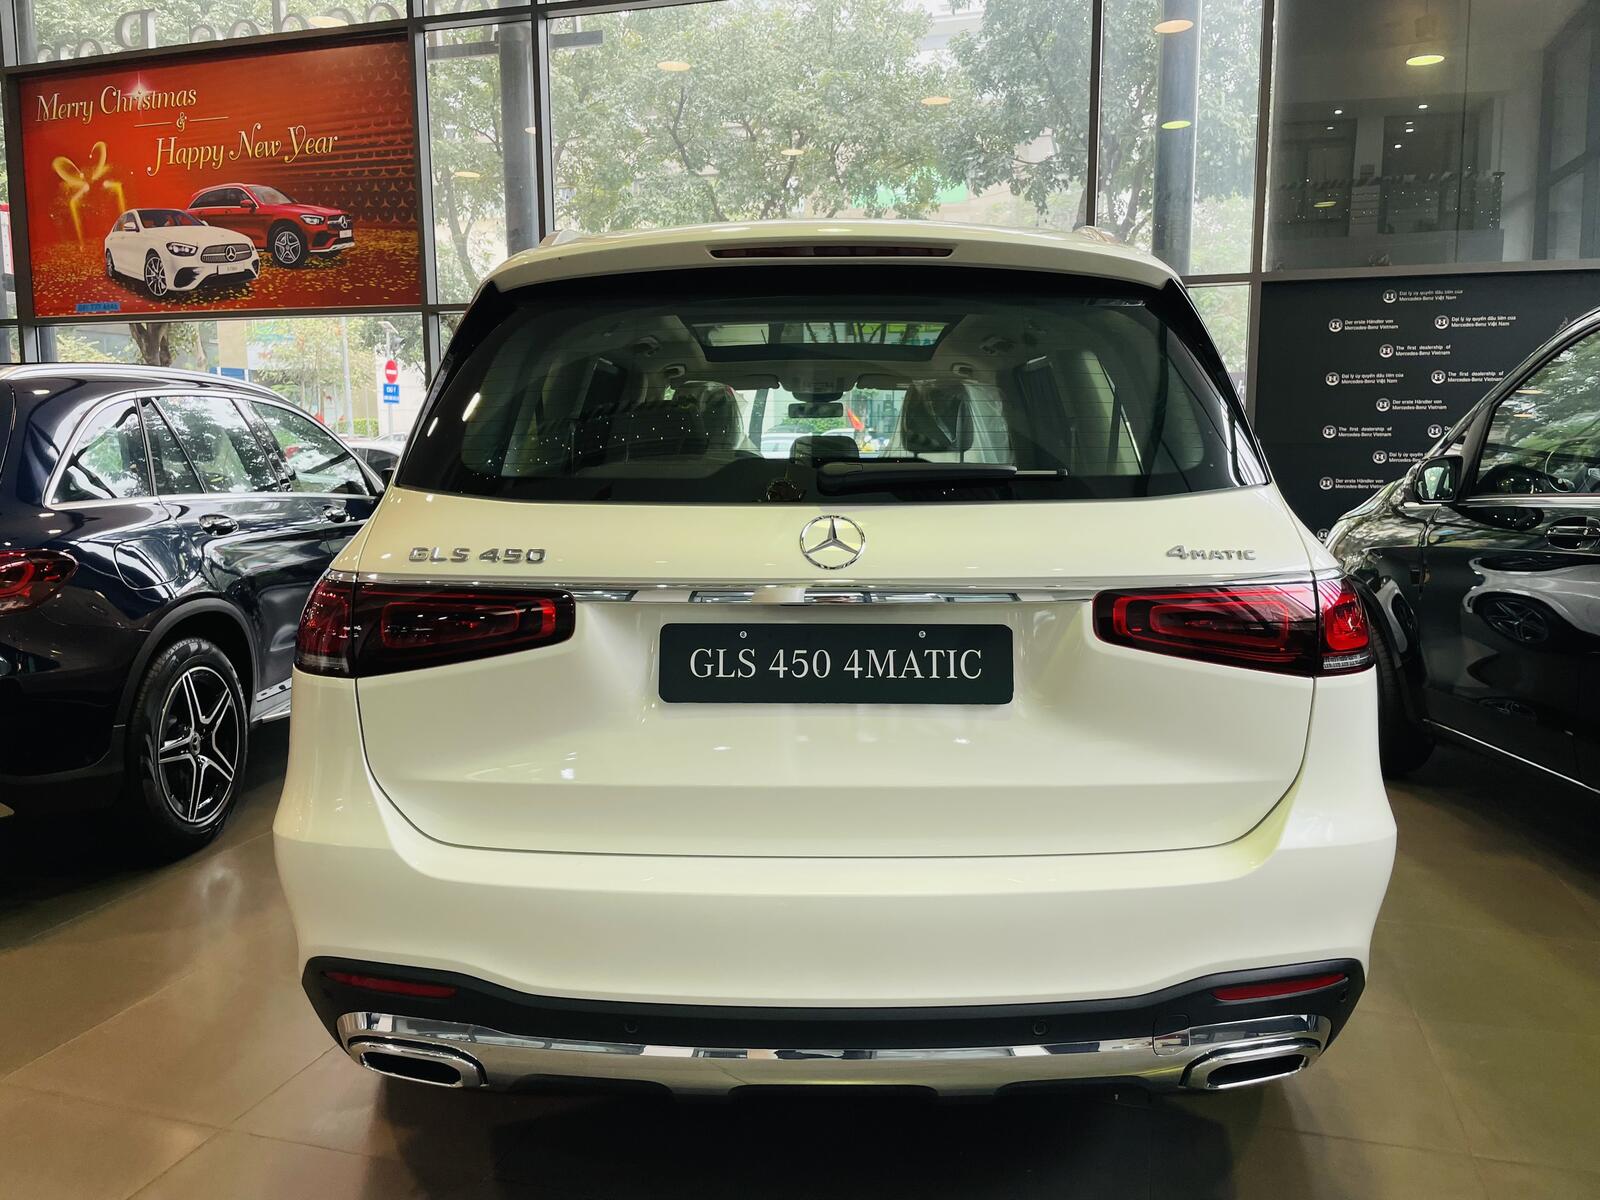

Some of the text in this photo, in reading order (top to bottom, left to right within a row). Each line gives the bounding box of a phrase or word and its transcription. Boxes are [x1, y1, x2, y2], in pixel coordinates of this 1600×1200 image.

[35, 85, 197, 124] Merry Christmas
[176, 112, 187, 132] &
[147, 122, 339, 177] Happy New Year
[409, 547, 546, 564] GLS 450
[1166, 544, 1256, 561] 4MATIC
[690, 648, 982, 679] GLS 450 4MATIC
